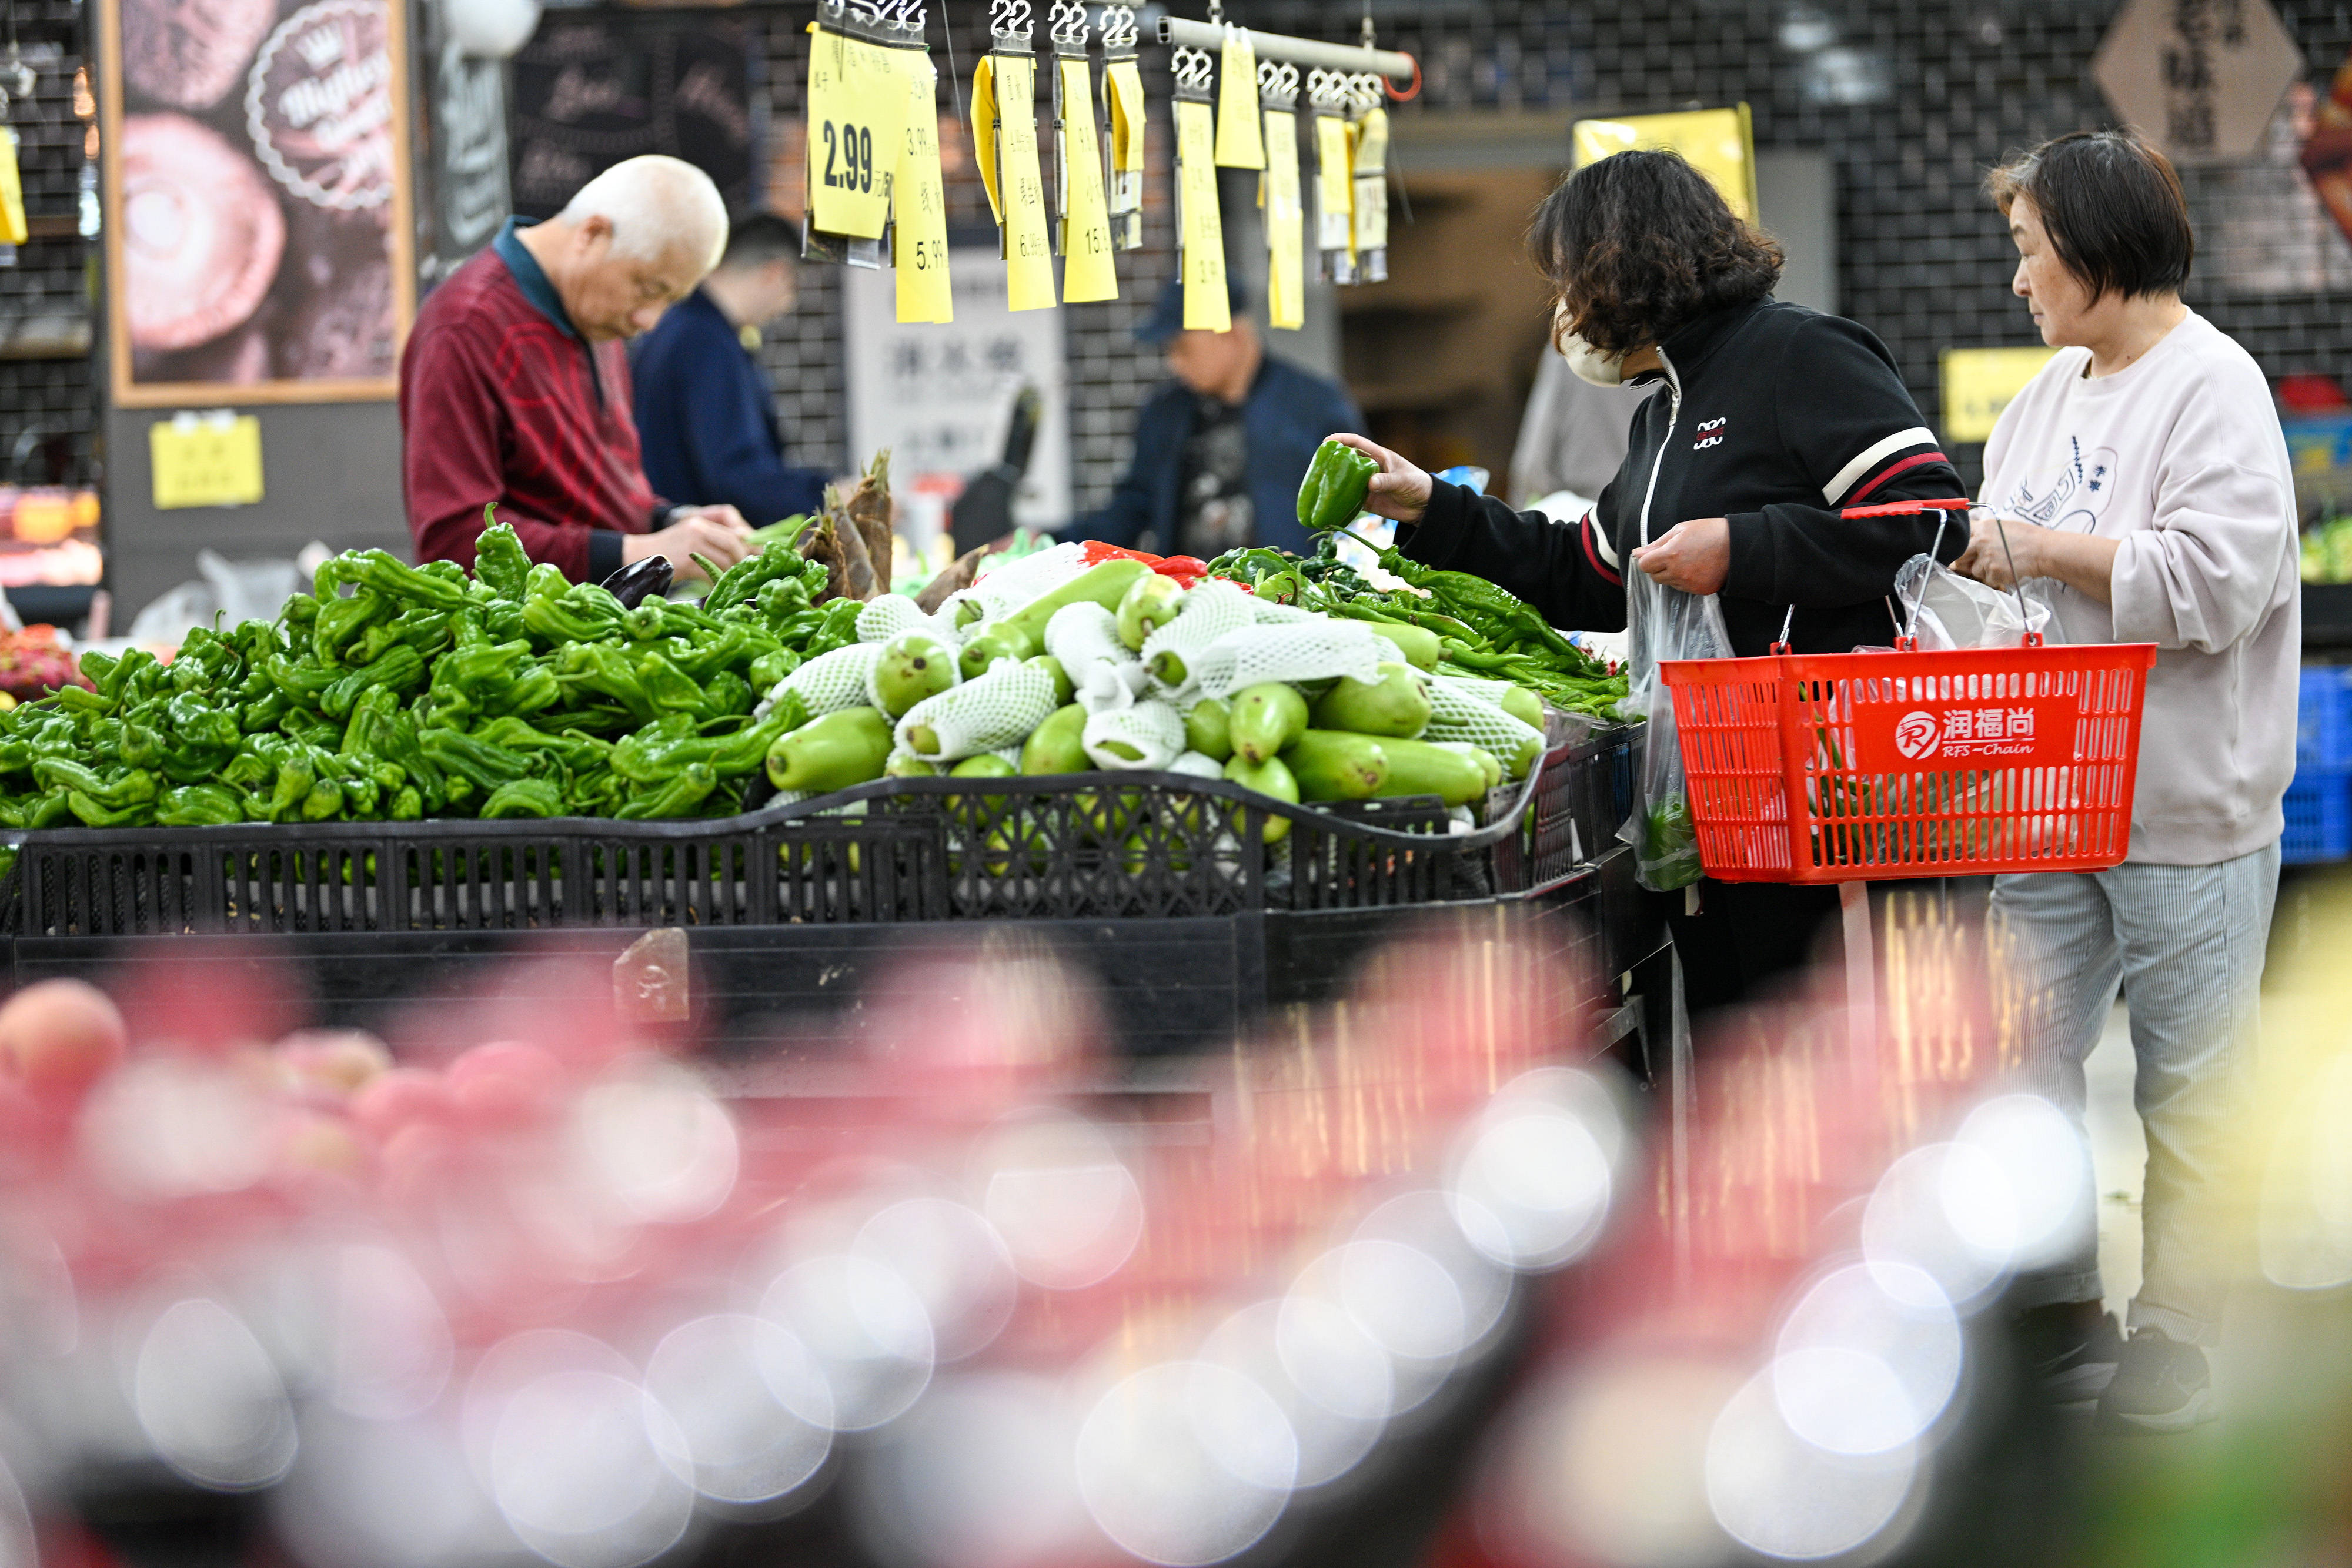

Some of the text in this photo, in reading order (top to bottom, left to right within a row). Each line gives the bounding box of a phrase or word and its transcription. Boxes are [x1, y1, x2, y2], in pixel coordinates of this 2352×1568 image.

[823, 119, 873, 194] 2.99
[916, 240, 944, 270] 5.99
[1942, 707, 2035, 739] 润福尚
